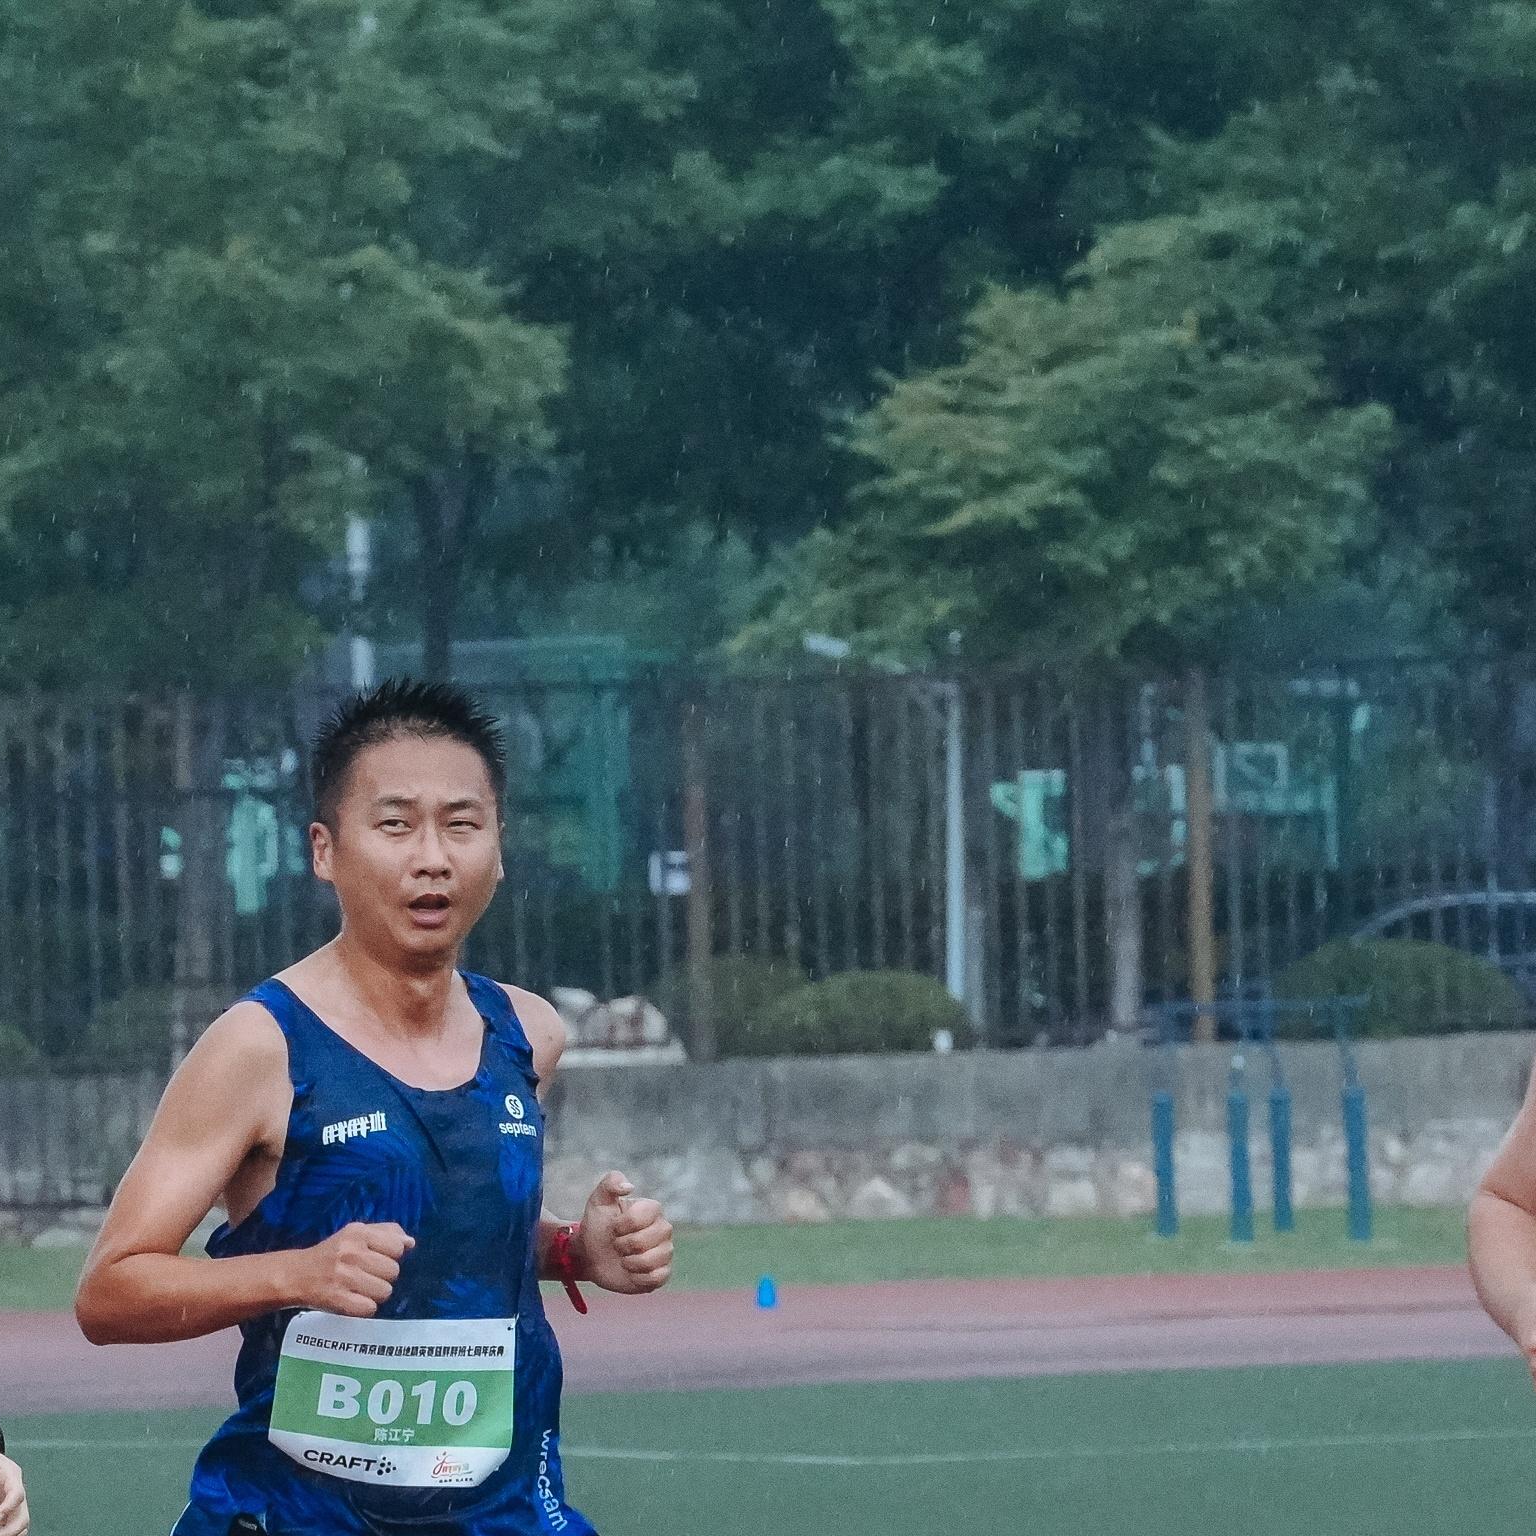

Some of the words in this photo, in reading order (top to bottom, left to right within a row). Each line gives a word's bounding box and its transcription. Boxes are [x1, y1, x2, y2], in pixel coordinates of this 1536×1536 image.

[499, 1121, 537, 1138] septem
[317, 1373, 477, 1426] B010
[303, 1450, 377, 1473] CRAFT
[537, 1428, 568, 1531] wrecsam
